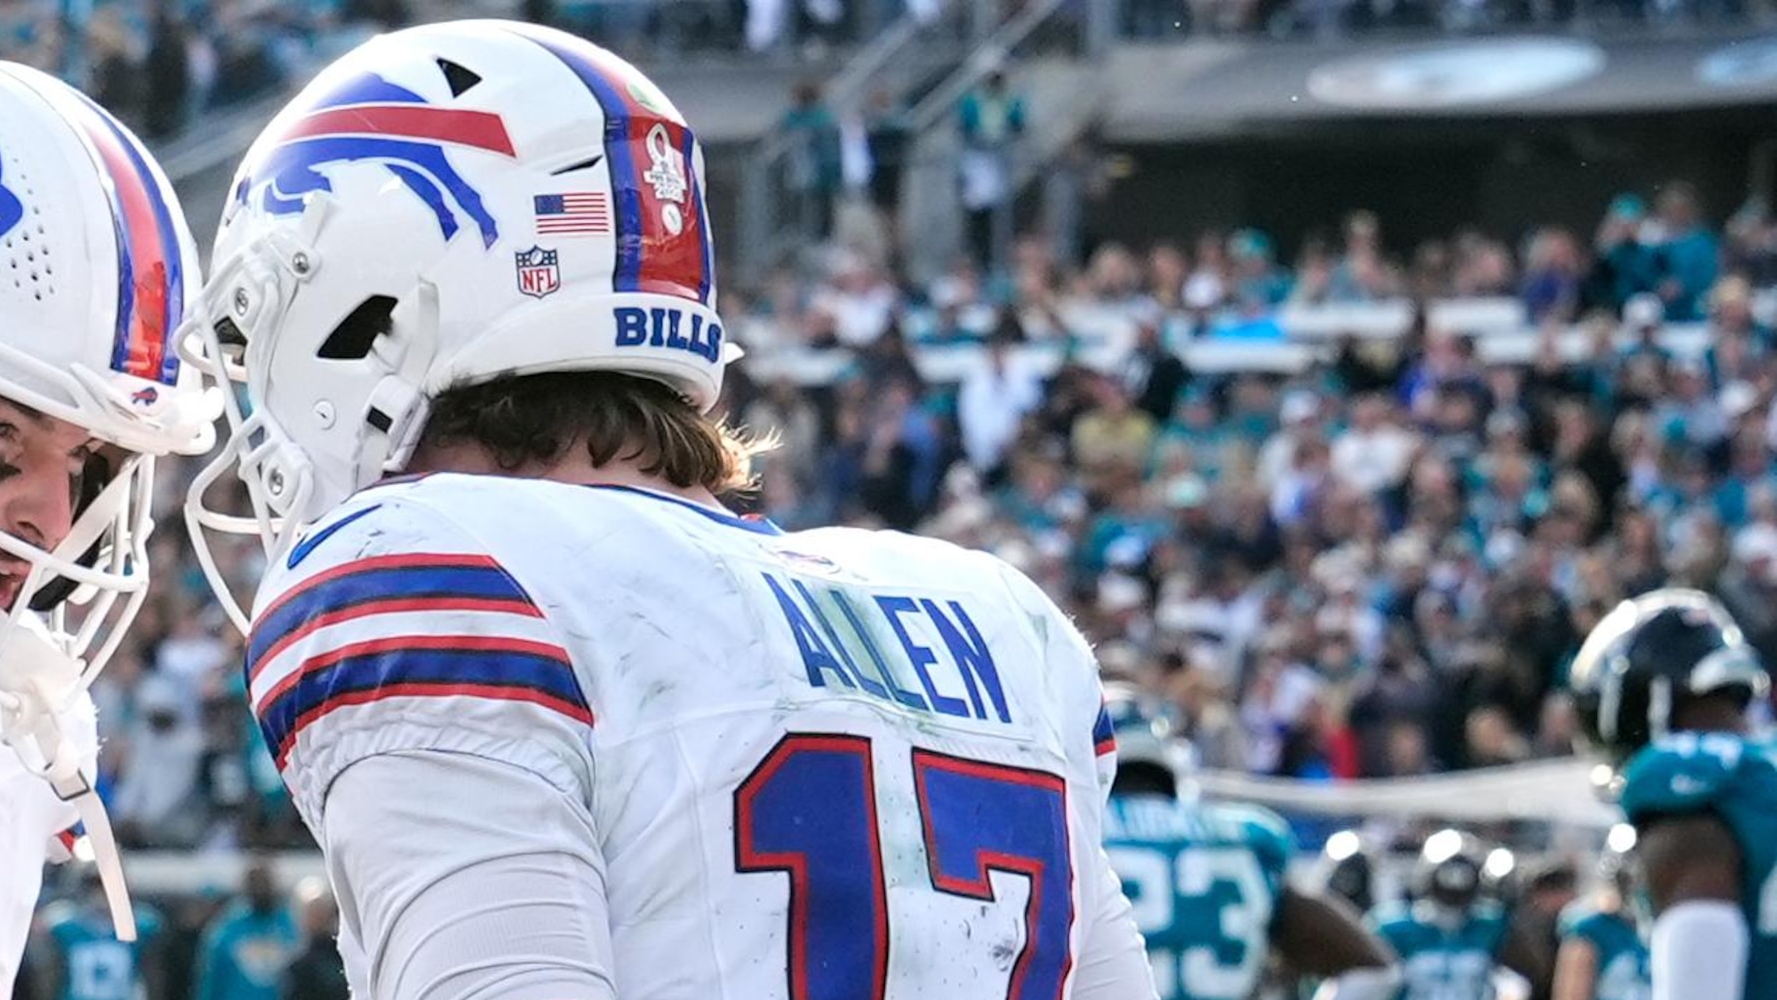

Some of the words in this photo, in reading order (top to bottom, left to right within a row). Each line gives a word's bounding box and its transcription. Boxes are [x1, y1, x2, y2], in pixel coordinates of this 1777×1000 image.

[522, 268, 556, 293] NFL
[613, 307, 722, 364] BILLS
[762, 572, 1013, 724] ALLEN
